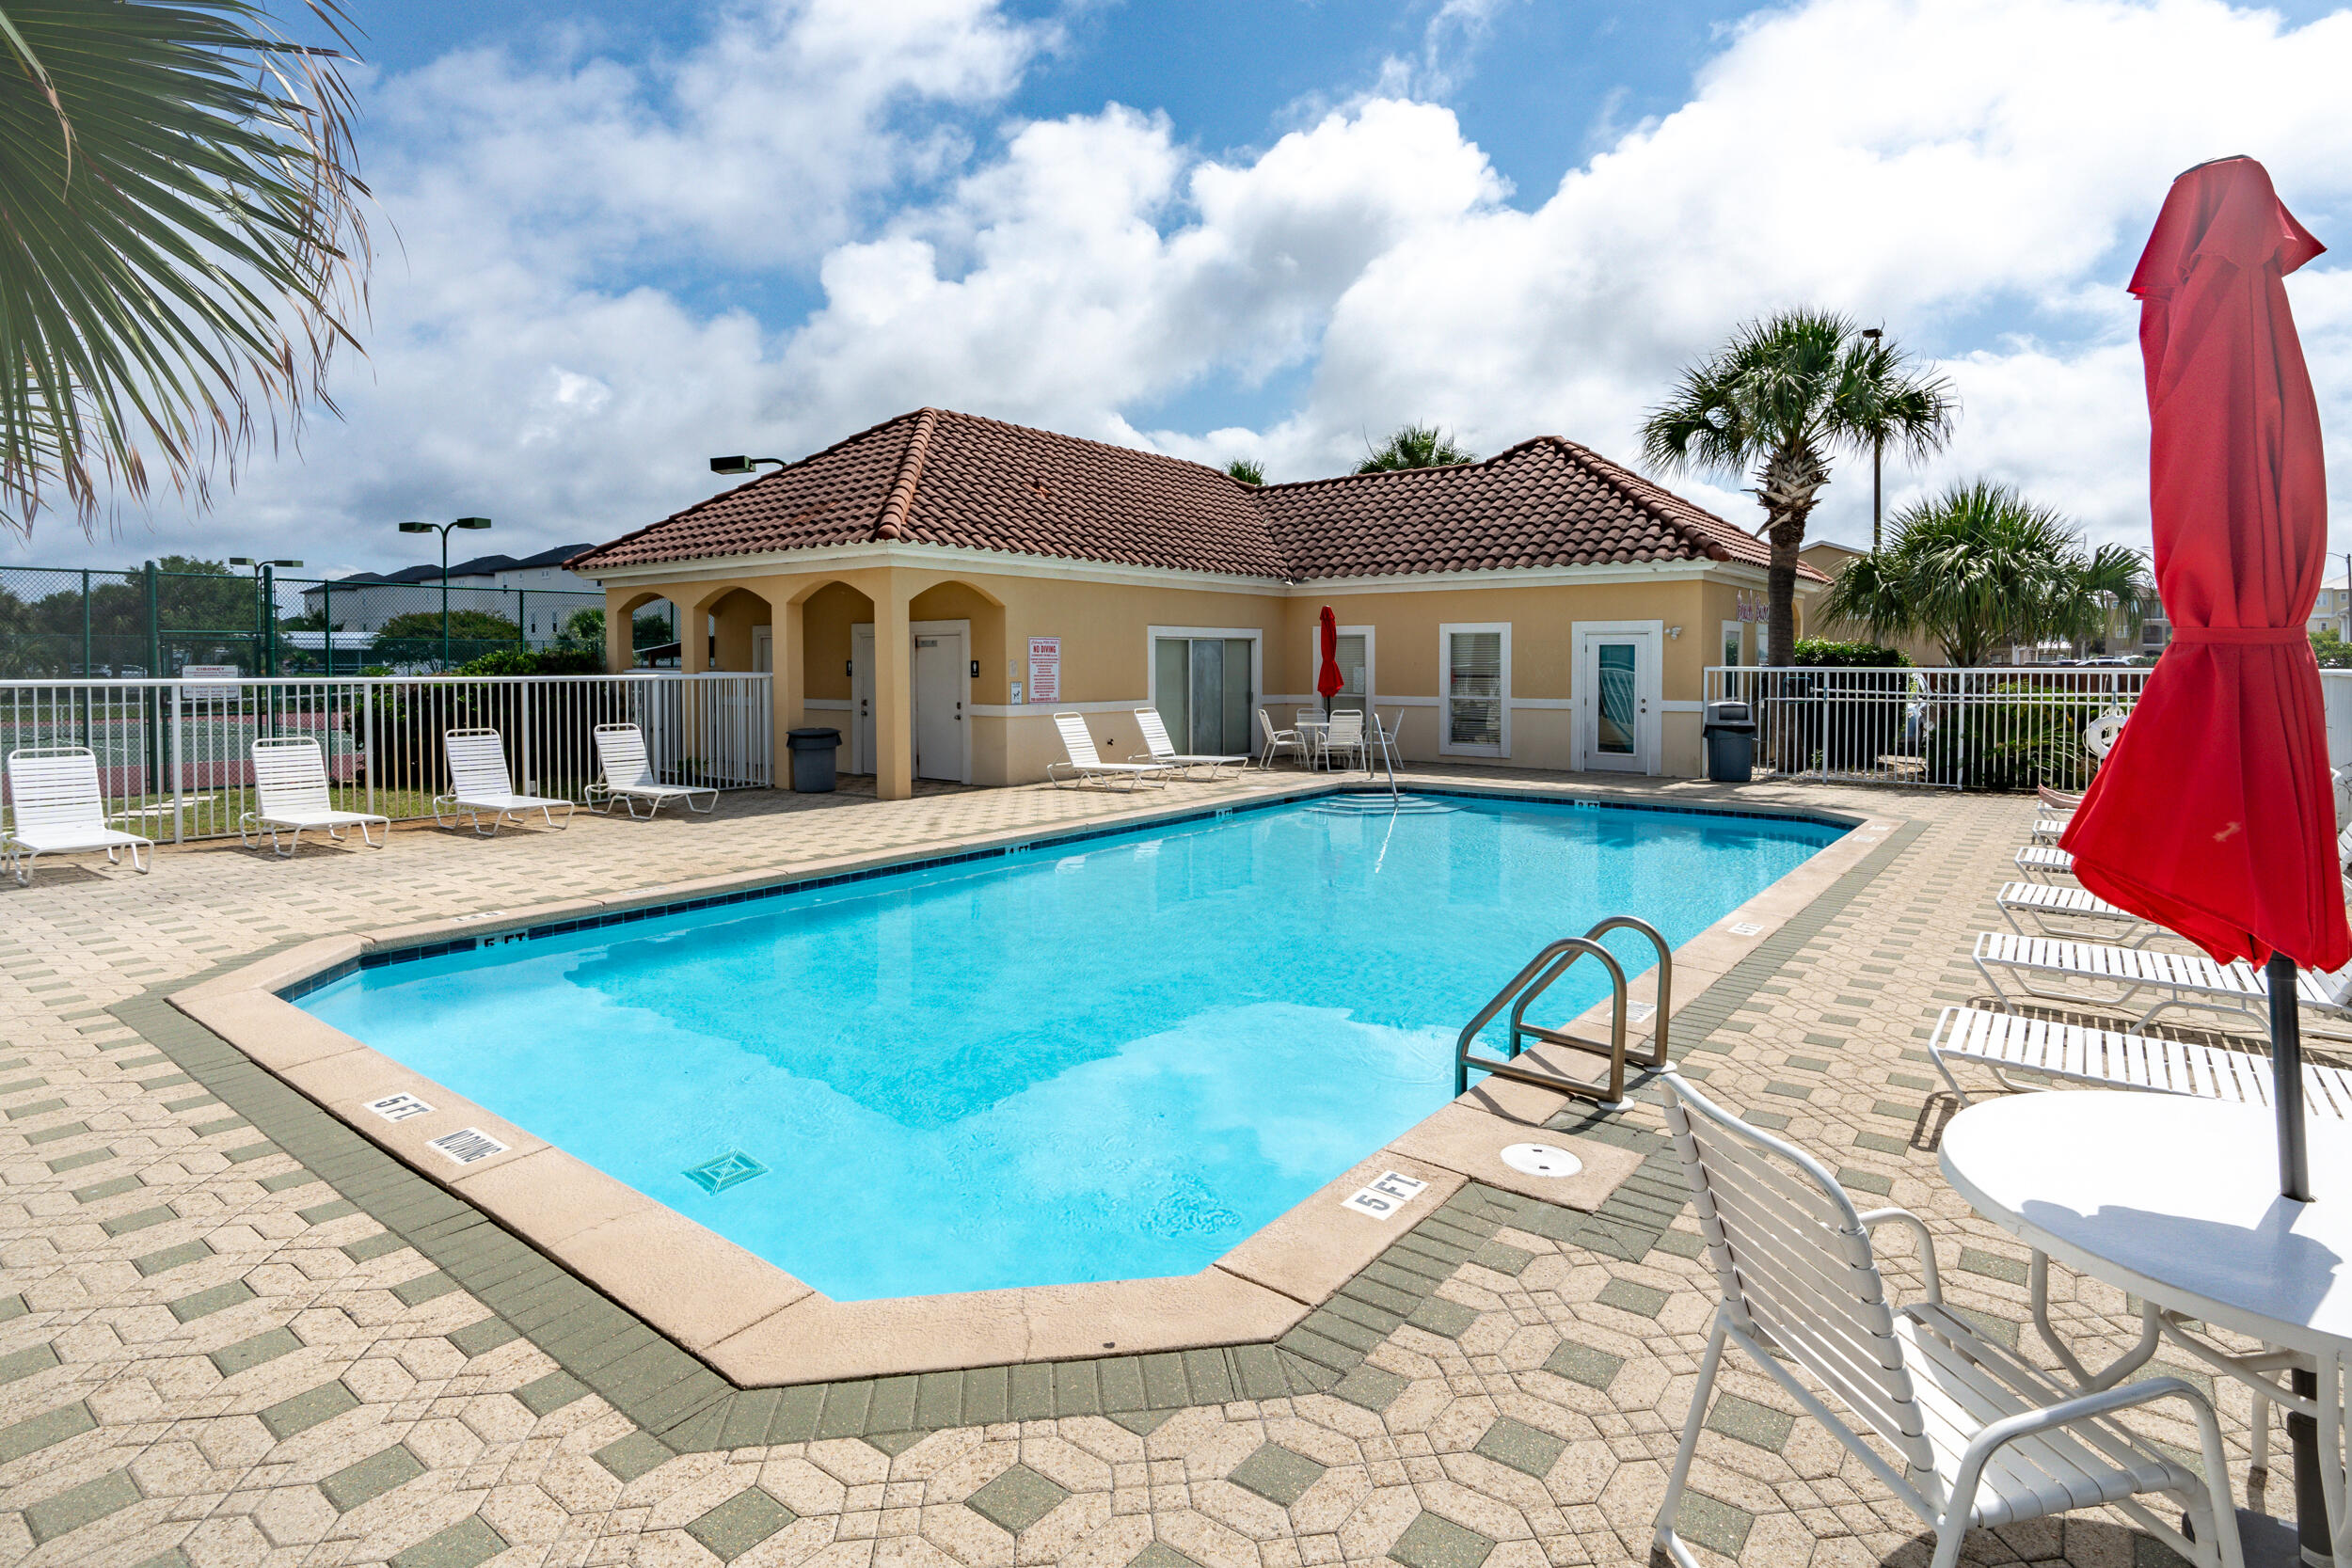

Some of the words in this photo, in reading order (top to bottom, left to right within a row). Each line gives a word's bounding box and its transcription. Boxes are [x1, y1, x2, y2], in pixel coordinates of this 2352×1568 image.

[374, 1096, 409, 1108] 5
[432, 1129, 475, 1147] NO
[443, 1135, 502, 1163] DIVING
[1354, 1194, 1391, 1212] 5
[1374, 1172, 1422, 1198] FT.
